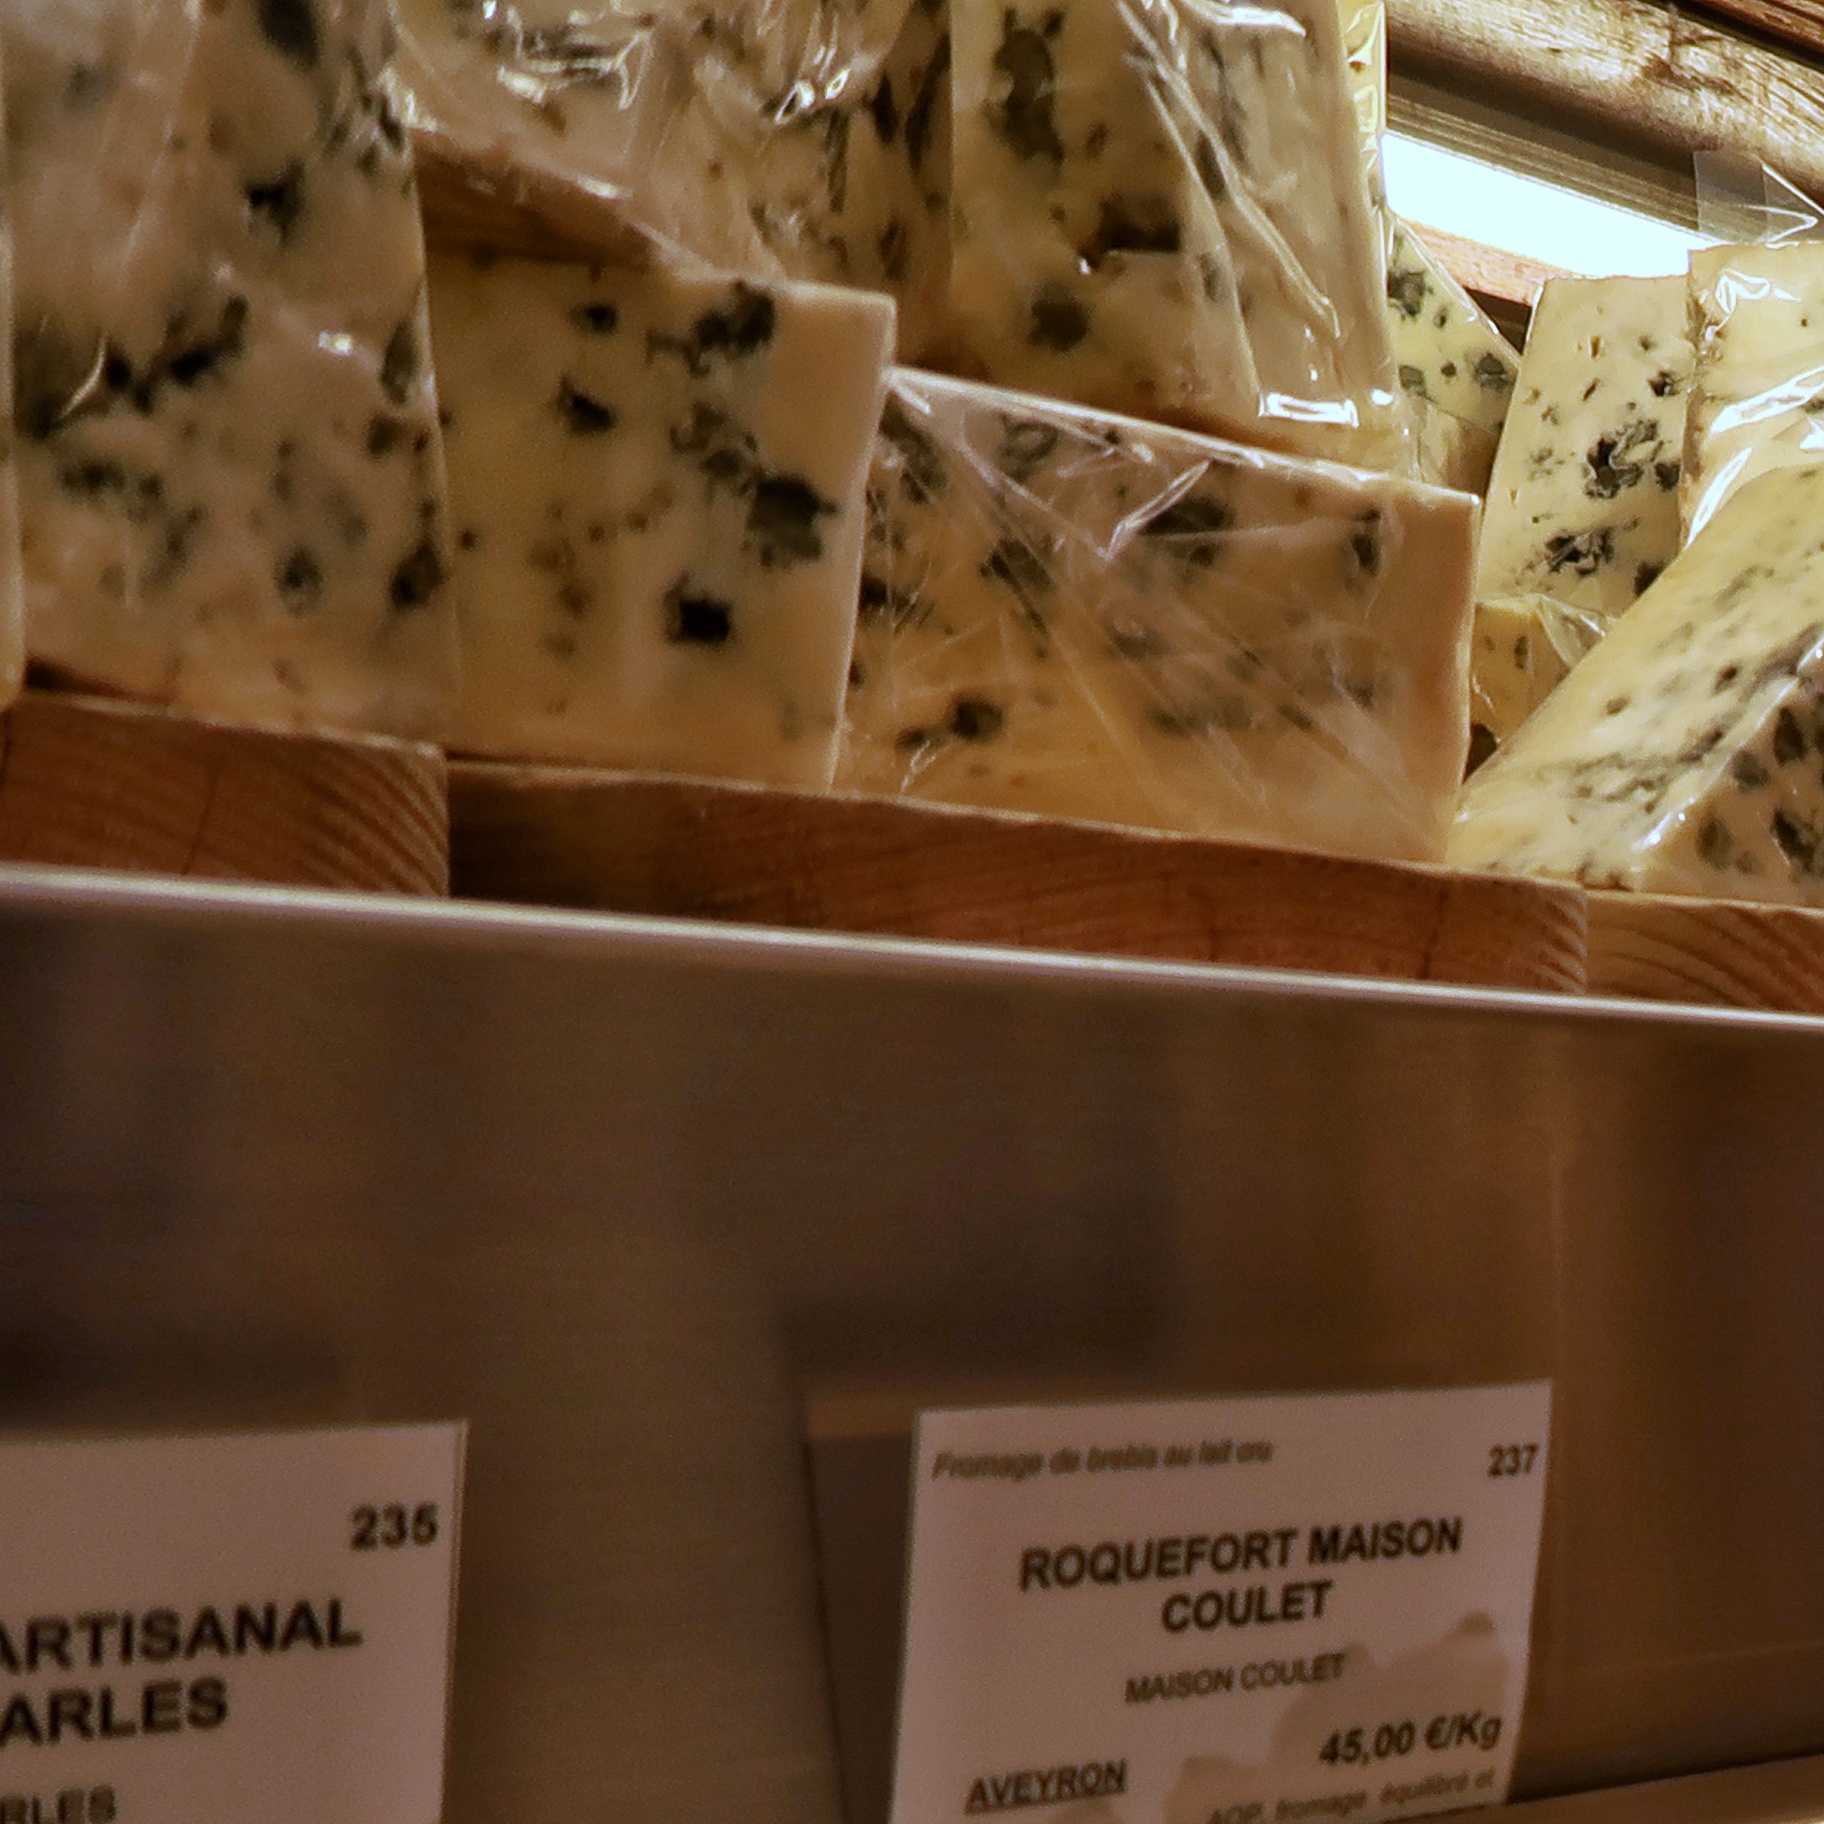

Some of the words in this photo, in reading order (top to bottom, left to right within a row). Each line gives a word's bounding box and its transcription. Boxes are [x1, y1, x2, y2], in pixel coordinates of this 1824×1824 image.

[1487, 1443, 1539, 1479] 237
[350, 1504, 438, 1551] 235
[1019, 1528, 1298, 1592] ROQUEFORT
[1307, 1516, 1464, 1566] MAISON
[1161, 1580, 1333, 1634] COULET
[1124, 1668, 1234, 1704] MAISON
[1240, 1652, 1346, 1692] COULET
[1318, 1720, 1414, 1767] 45,00
[1424, 1708, 1502, 1751] €/Kg
[964, 1759, 1128, 1817] AVEYRON
